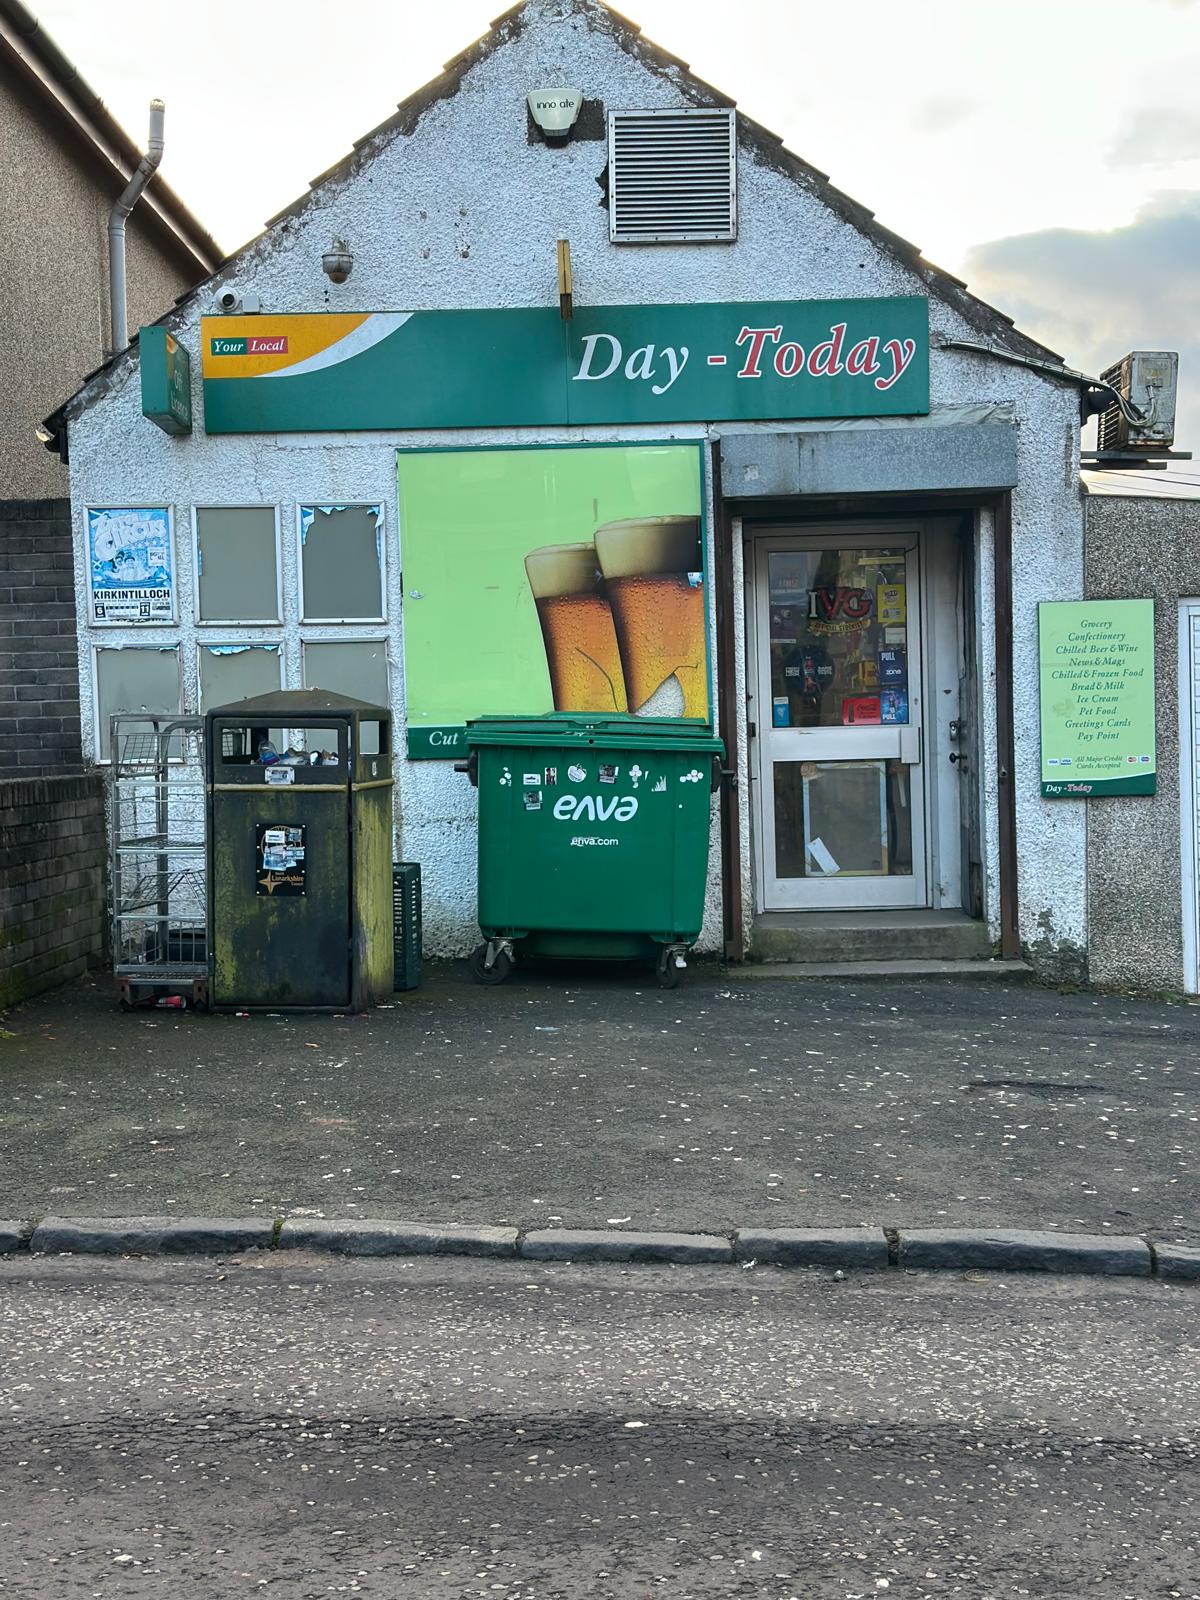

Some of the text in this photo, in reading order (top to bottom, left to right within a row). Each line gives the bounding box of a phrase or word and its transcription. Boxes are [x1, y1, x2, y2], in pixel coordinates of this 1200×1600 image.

[214, 338, 285, 352] Your Local
[571, 332, 689, 395] Day
[735, 322, 916, 391] Today
[93, 589, 170, 600] KIRKINTILLOCH
[808, 586, 872, 620] IVG
[96, 606, 103, 615] 6
[1080, 619, 1112, 630] Grocery
[1068, 632, 1126, 642] Confectionery
[1056, 645, 1087, 654] Chilled
[1090, 645, 1109, 653] Beer
[1118, 644, 1139, 652] Wine
[881, 652, 896, 661] PULL
[1069, 657, 1126, 666] News & Mags
[1052, 668, 1144, 679] Chilled & Frozen Food
[1071, 681, 1125, 690] Bread & Milk
[1077, 694, 1119, 703] Ice Cream
[1080, 706, 1117, 716] Pet Food
[1065, 718, 1132, 729] Greetings Cards
[428, 730, 459, 746] Cut
[1077, 731, 1120, 742] Pay Point
[1094, 762, 1121, 770] Accepted
[1046, 784, 1062, 794] Day
[1067, 783, 1092, 793] Today
[552, 794, 639, 822] enva
[570, 836, 619, 847] enva.com
